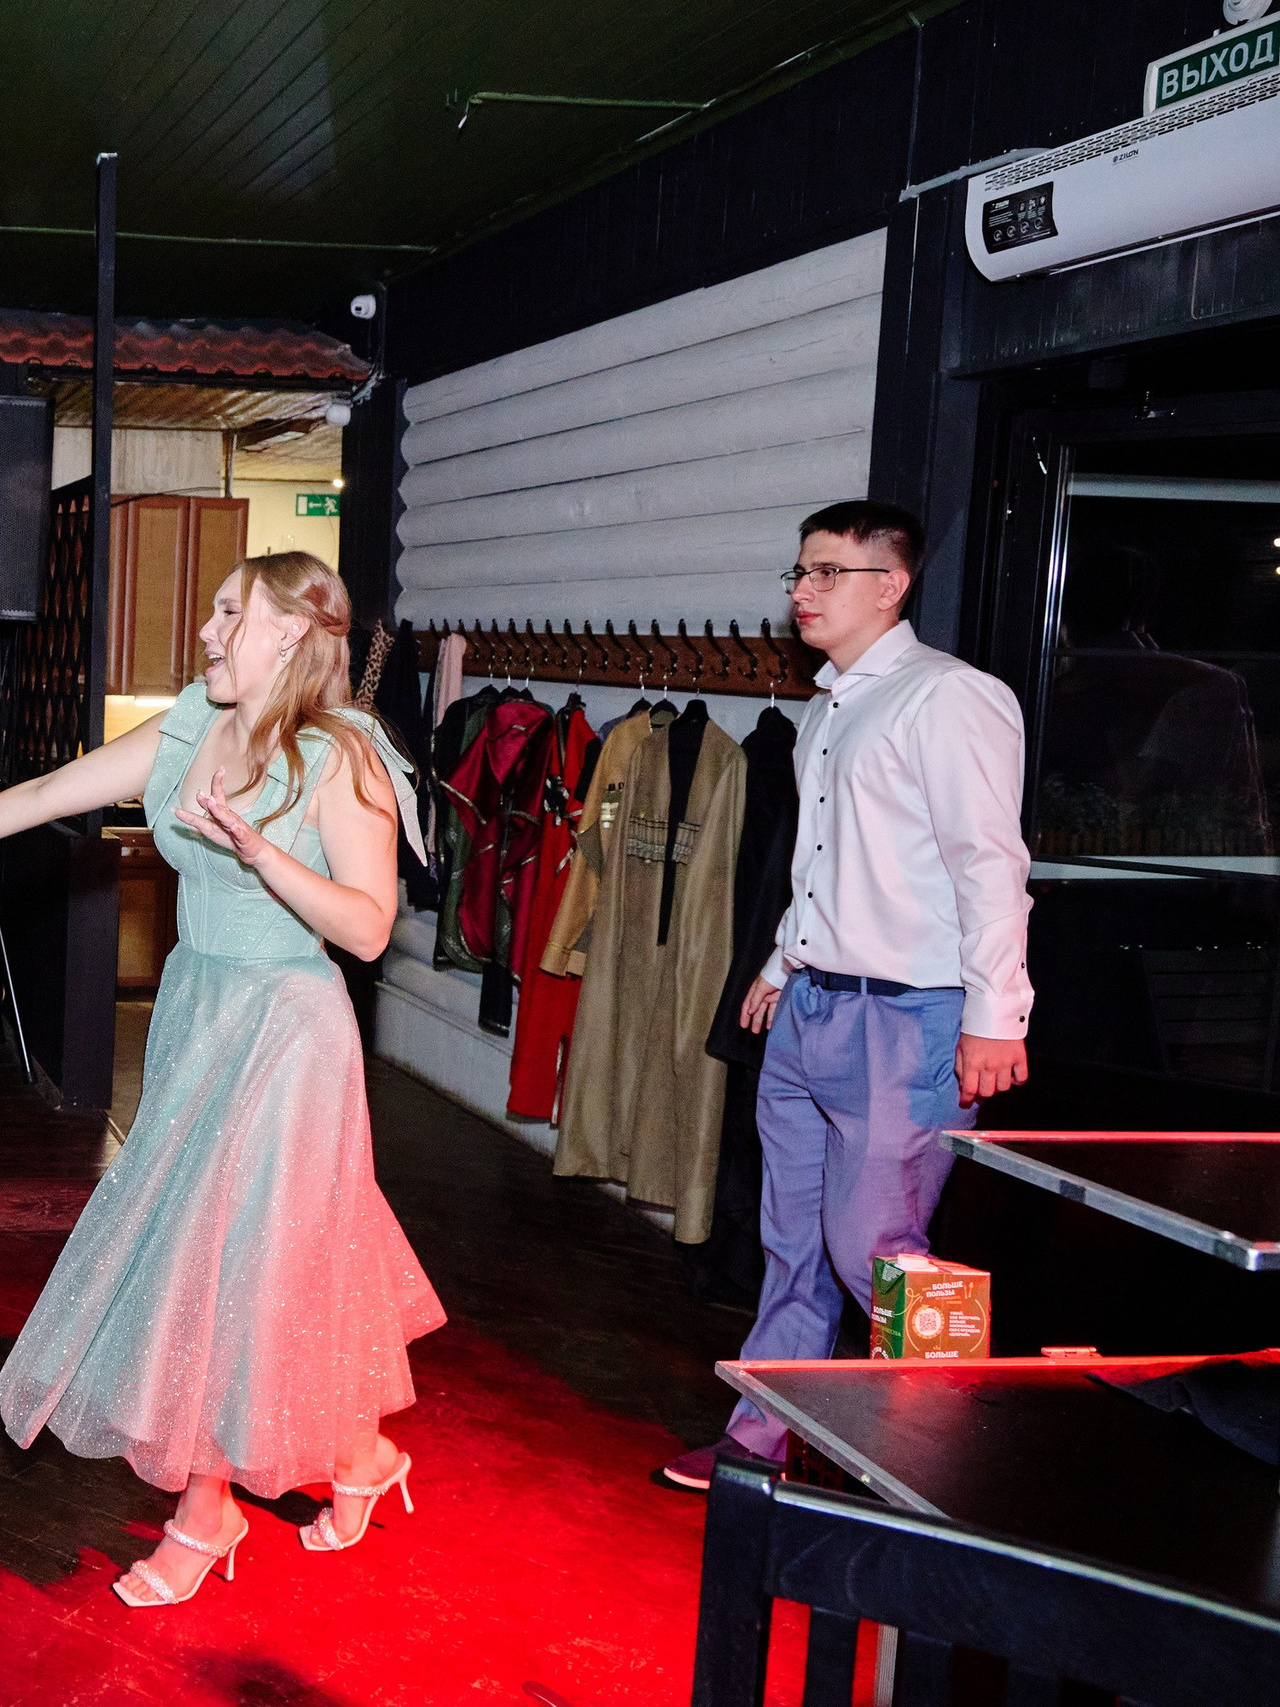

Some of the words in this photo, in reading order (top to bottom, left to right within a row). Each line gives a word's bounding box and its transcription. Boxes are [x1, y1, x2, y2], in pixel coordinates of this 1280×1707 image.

[1161, 31, 1274, 100] ВЫХОД
[1118, 149, 1139, 161] ZILON
[932, 1281, 963, 1290] БОЛЬШЕ
[926, 1289, 955, 1298] ПОЛЬЗЫ
[925, 1351, 958, 1359] БОЛЬШЕ
